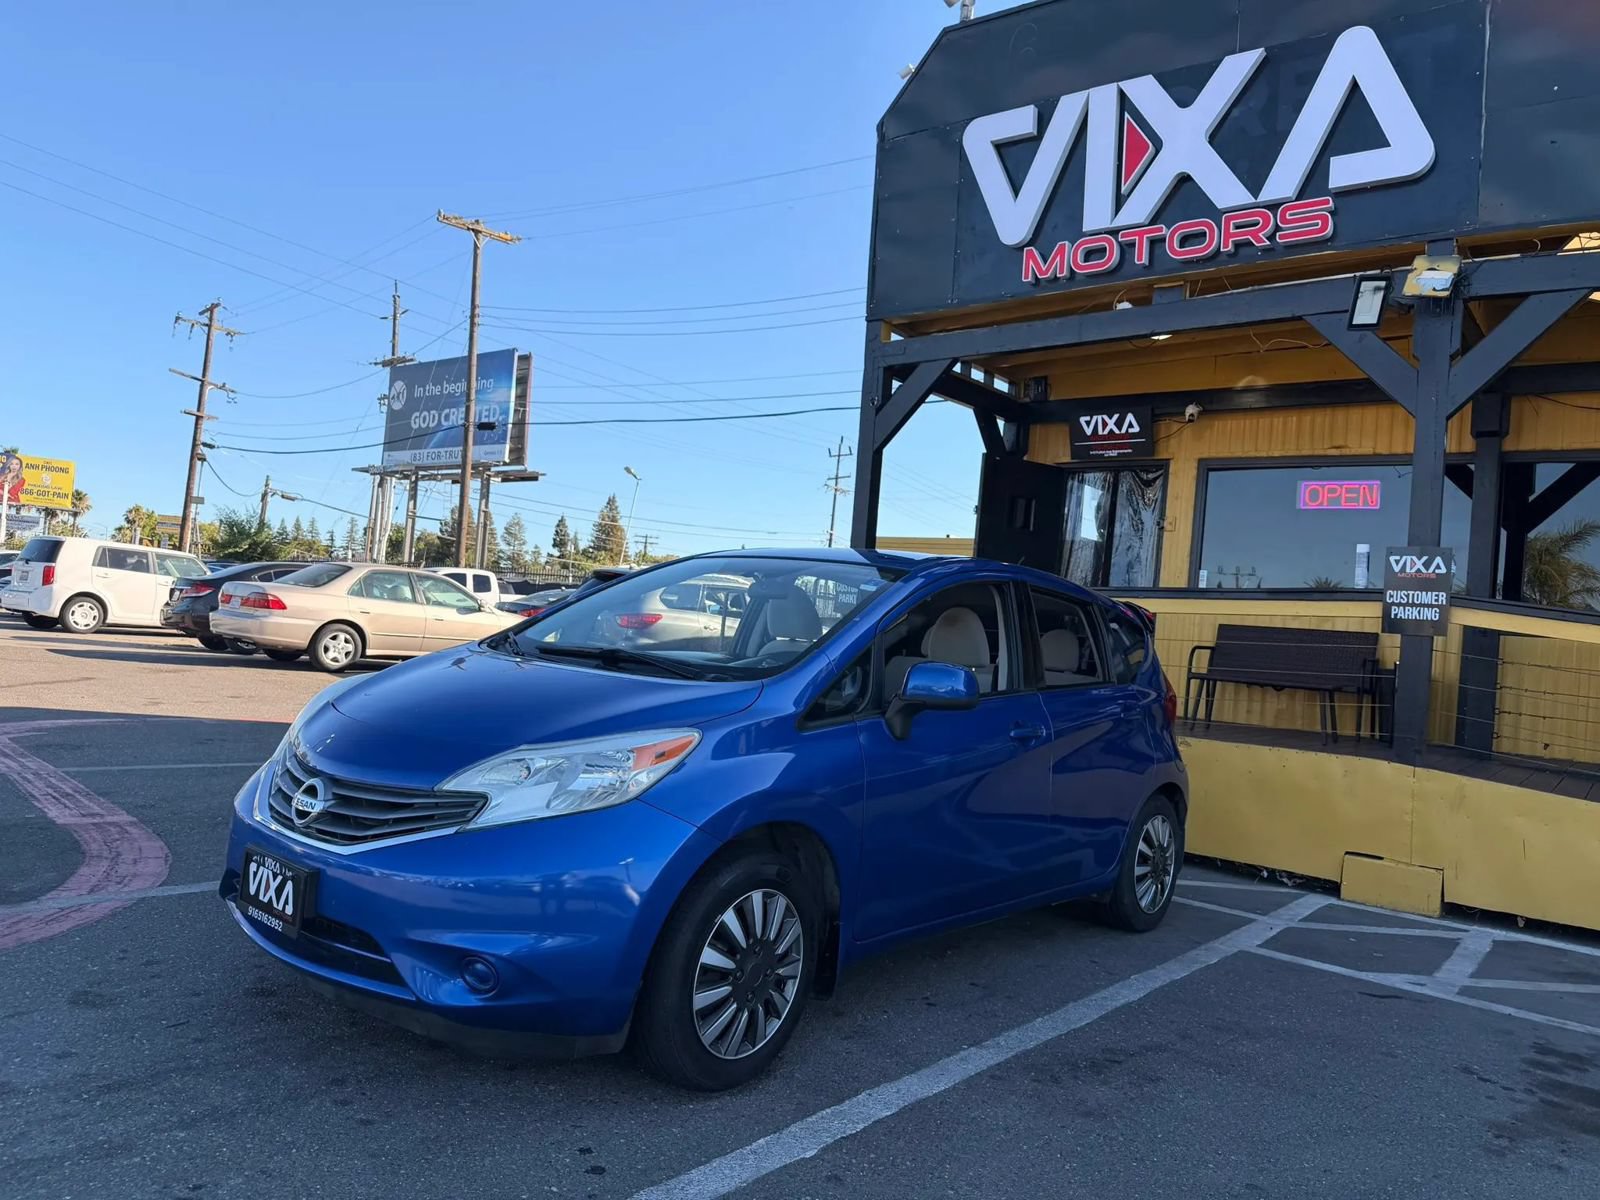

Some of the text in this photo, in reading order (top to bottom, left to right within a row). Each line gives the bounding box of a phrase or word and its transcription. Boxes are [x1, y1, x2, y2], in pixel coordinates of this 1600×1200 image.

[963, 25, 1436, 247] VIXA
[1022, 197, 1335, 282] MOTORS
[414, 377, 494, 398] In the begiing
[411, 404, 503, 429] GOD CRETED.
[1080, 412, 1140, 436] VIXA
[426, 447, 464, 460] FOR-TRU
[25, 463, 69, 475] ANH PHOONG
[1305, 484, 1378, 507] OPEN
[1389, 555, 1447, 574] VIXA
[1386, 590, 1446, 605] CUSTOMER
[1391, 606, 1439, 621] PARKING
[249, 861, 294, 916] VIXA
